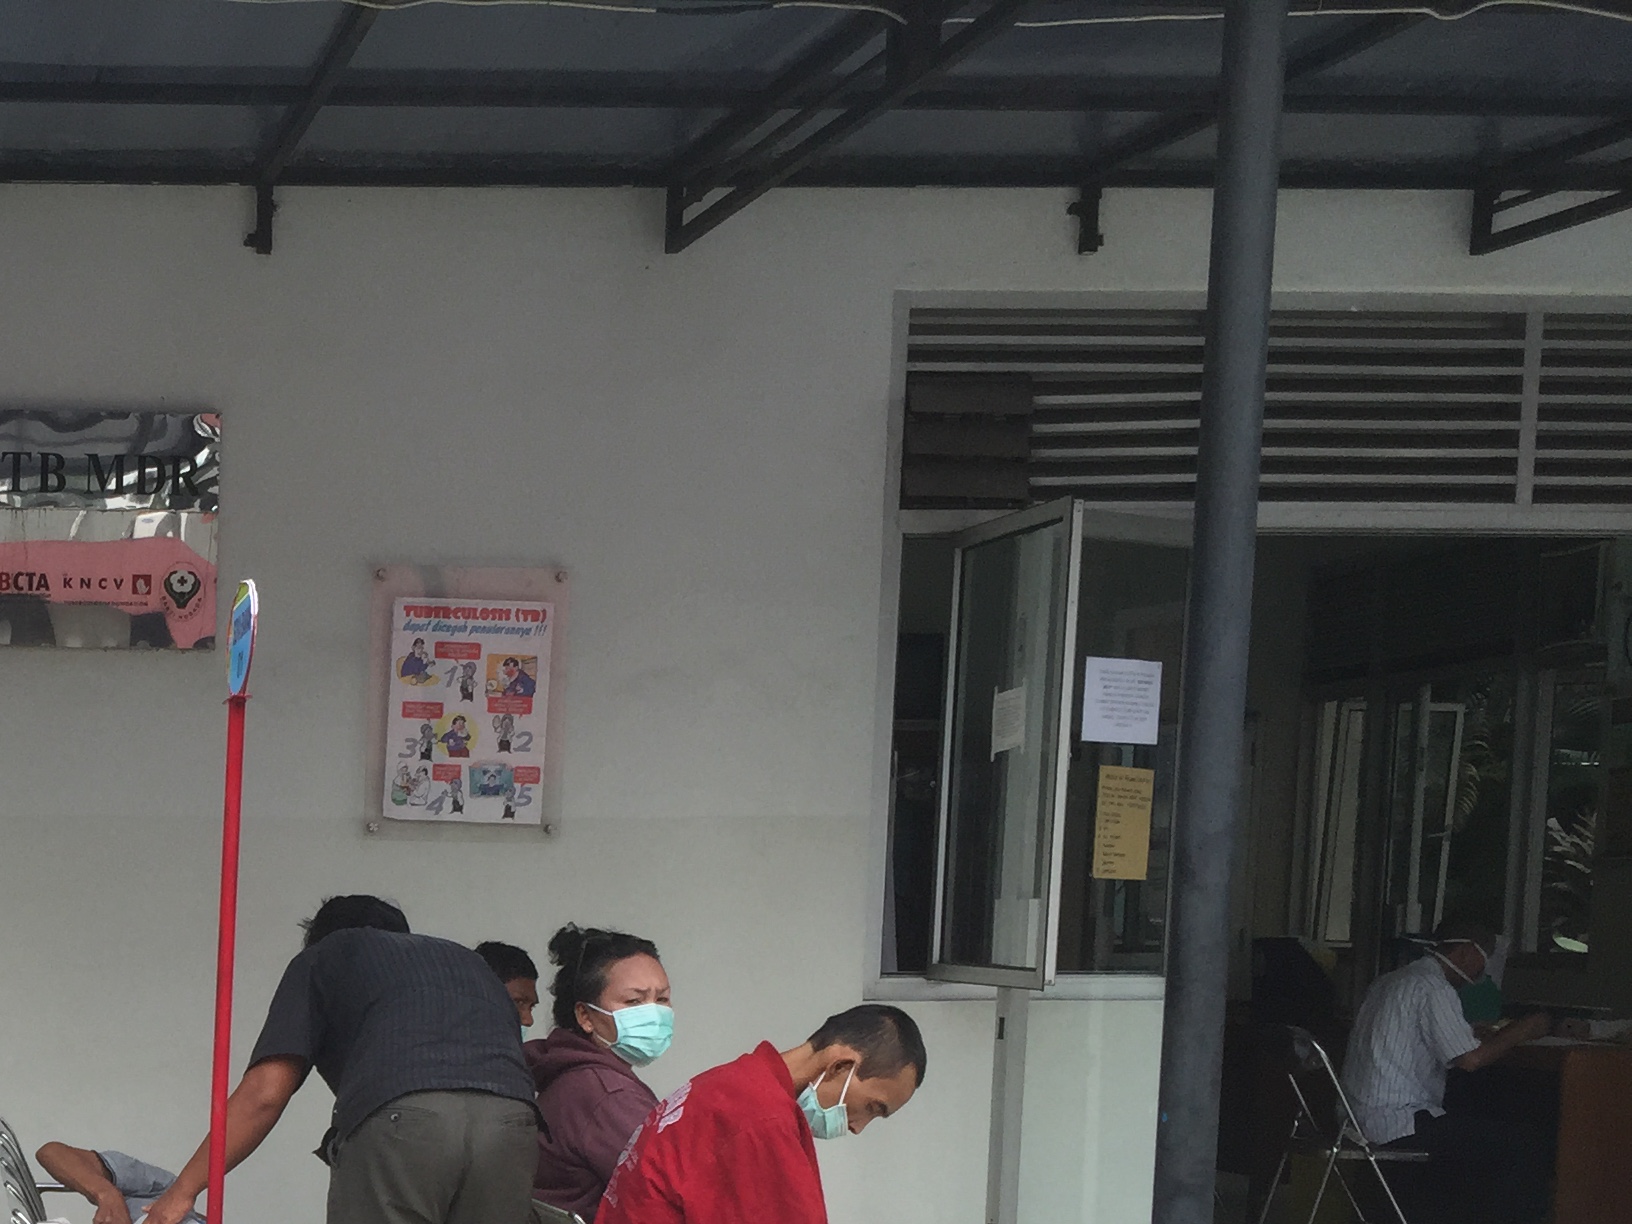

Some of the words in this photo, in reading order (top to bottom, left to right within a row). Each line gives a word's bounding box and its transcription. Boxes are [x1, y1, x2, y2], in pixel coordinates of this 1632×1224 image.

[1, 451, 67, 494] TB
[84, 453, 201, 497] MDR
[403, 605, 512, 622] TUBERCULOSIS
[515, 607, 547, 623] (TB)
[403, 619, 432, 635] dapat
[444, 665, 458, 688] 1
[398, 737, 418, 758] 3
[513, 731, 533, 753] 2
[426, 789, 448, 815] 4
[515, 786, 533, 807] 5
